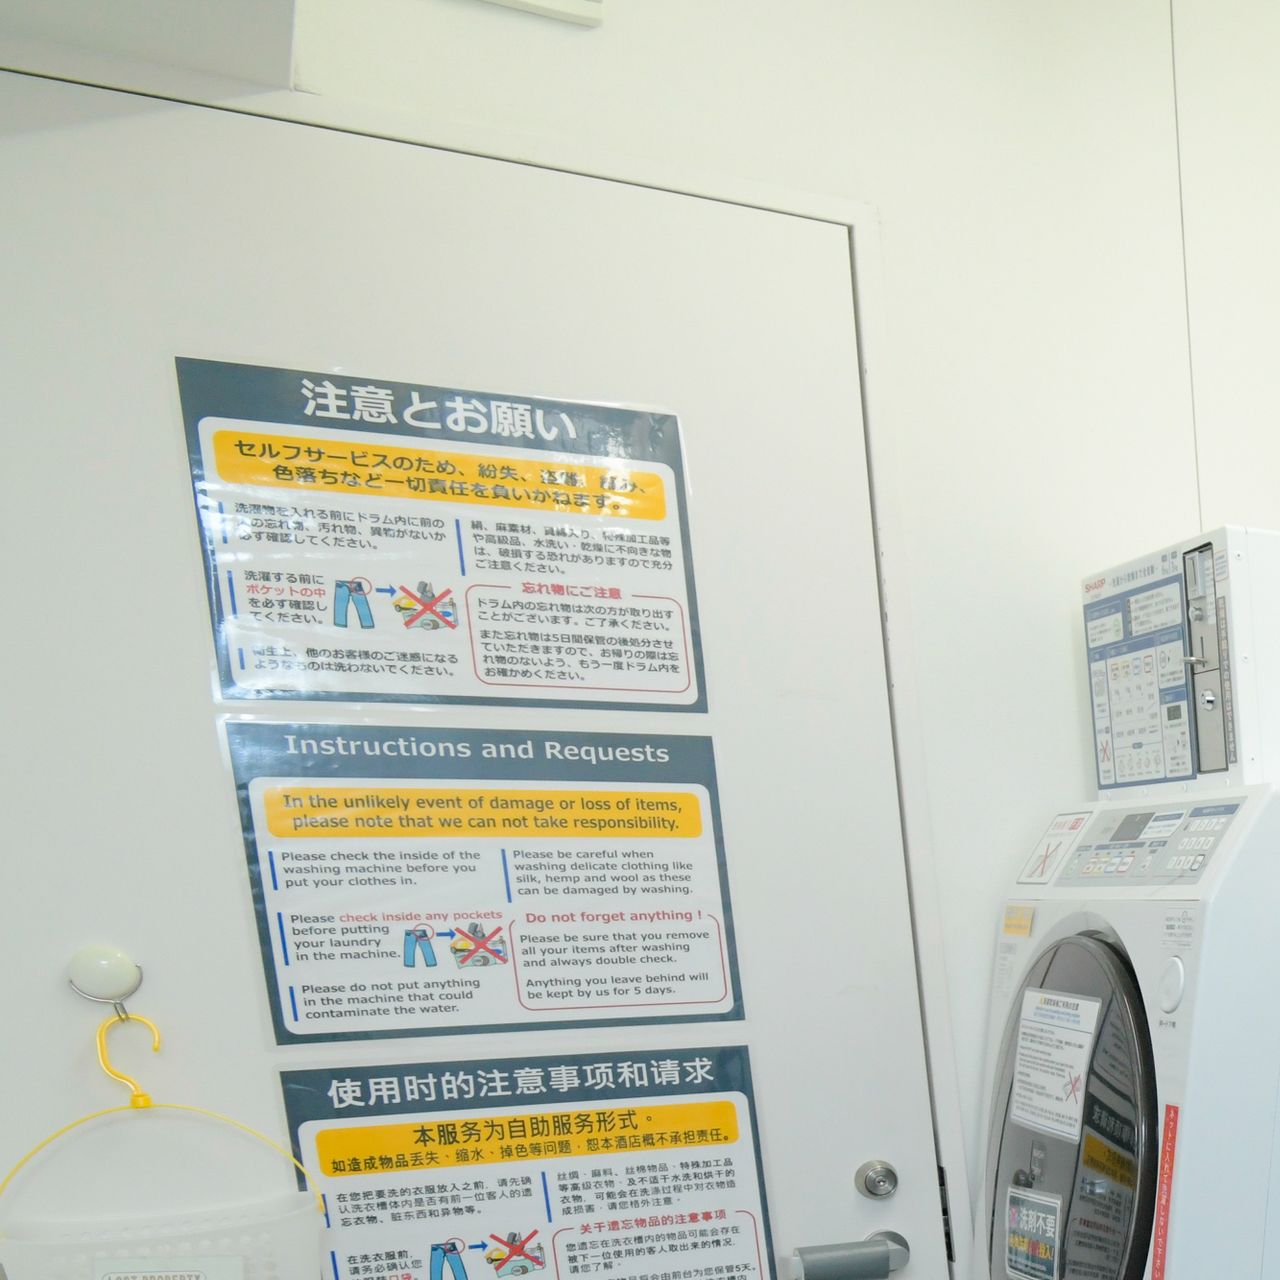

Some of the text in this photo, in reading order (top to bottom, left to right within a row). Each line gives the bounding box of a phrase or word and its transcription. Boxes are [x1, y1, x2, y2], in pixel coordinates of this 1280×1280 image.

[301, 378, 577, 440] 注意とお願い
[273, 464, 621, 510] 色落ちなど一切責任を負いかねます。
[244, 570, 324, 584] 洗濯する前に
[246, 584, 326, 596] ポケットの中
[522, 582, 622, 599] 忘れ物にご注意
[249, 598, 327, 611] を必ず確認し
[485, 668, 585, 680] お確かめください。
[284, 735, 669, 764] Instructions and Requests
[283, 794, 682, 813] In the unlikely event of damage or loss of items,
[293, 815, 679, 831] please note that we can not take responsibility.
[281, 851, 480, 861] Please check the inside of the
[513, 850, 654, 859] Please be careful when
[291, 910, 502, 923] Please check inside any pockets
[526, 910, 702, 923] Do not forget anything !
[526, 973, 709, 990] Anything you leave behind will
[528, 990, 543, 999] be
[547, 989, 573, 999] kept
[578, 989, 591, 998] by
[613, 987, 630, 996] for
[634, 987, 641, 995] 5
[645, 985, 676, 996] days.
[327, 1057, 715, 1109] 使用时的注意事项和请求
[413, 1109, 653, 1148] 本服务为自助服务形式。
[580, 1209, 727, 1234] 关于遗忘物品的注意事项
[349, 1259, 423, 1275] 请务必确认您
[569, 1261, 621, 1274] 请您了解。
